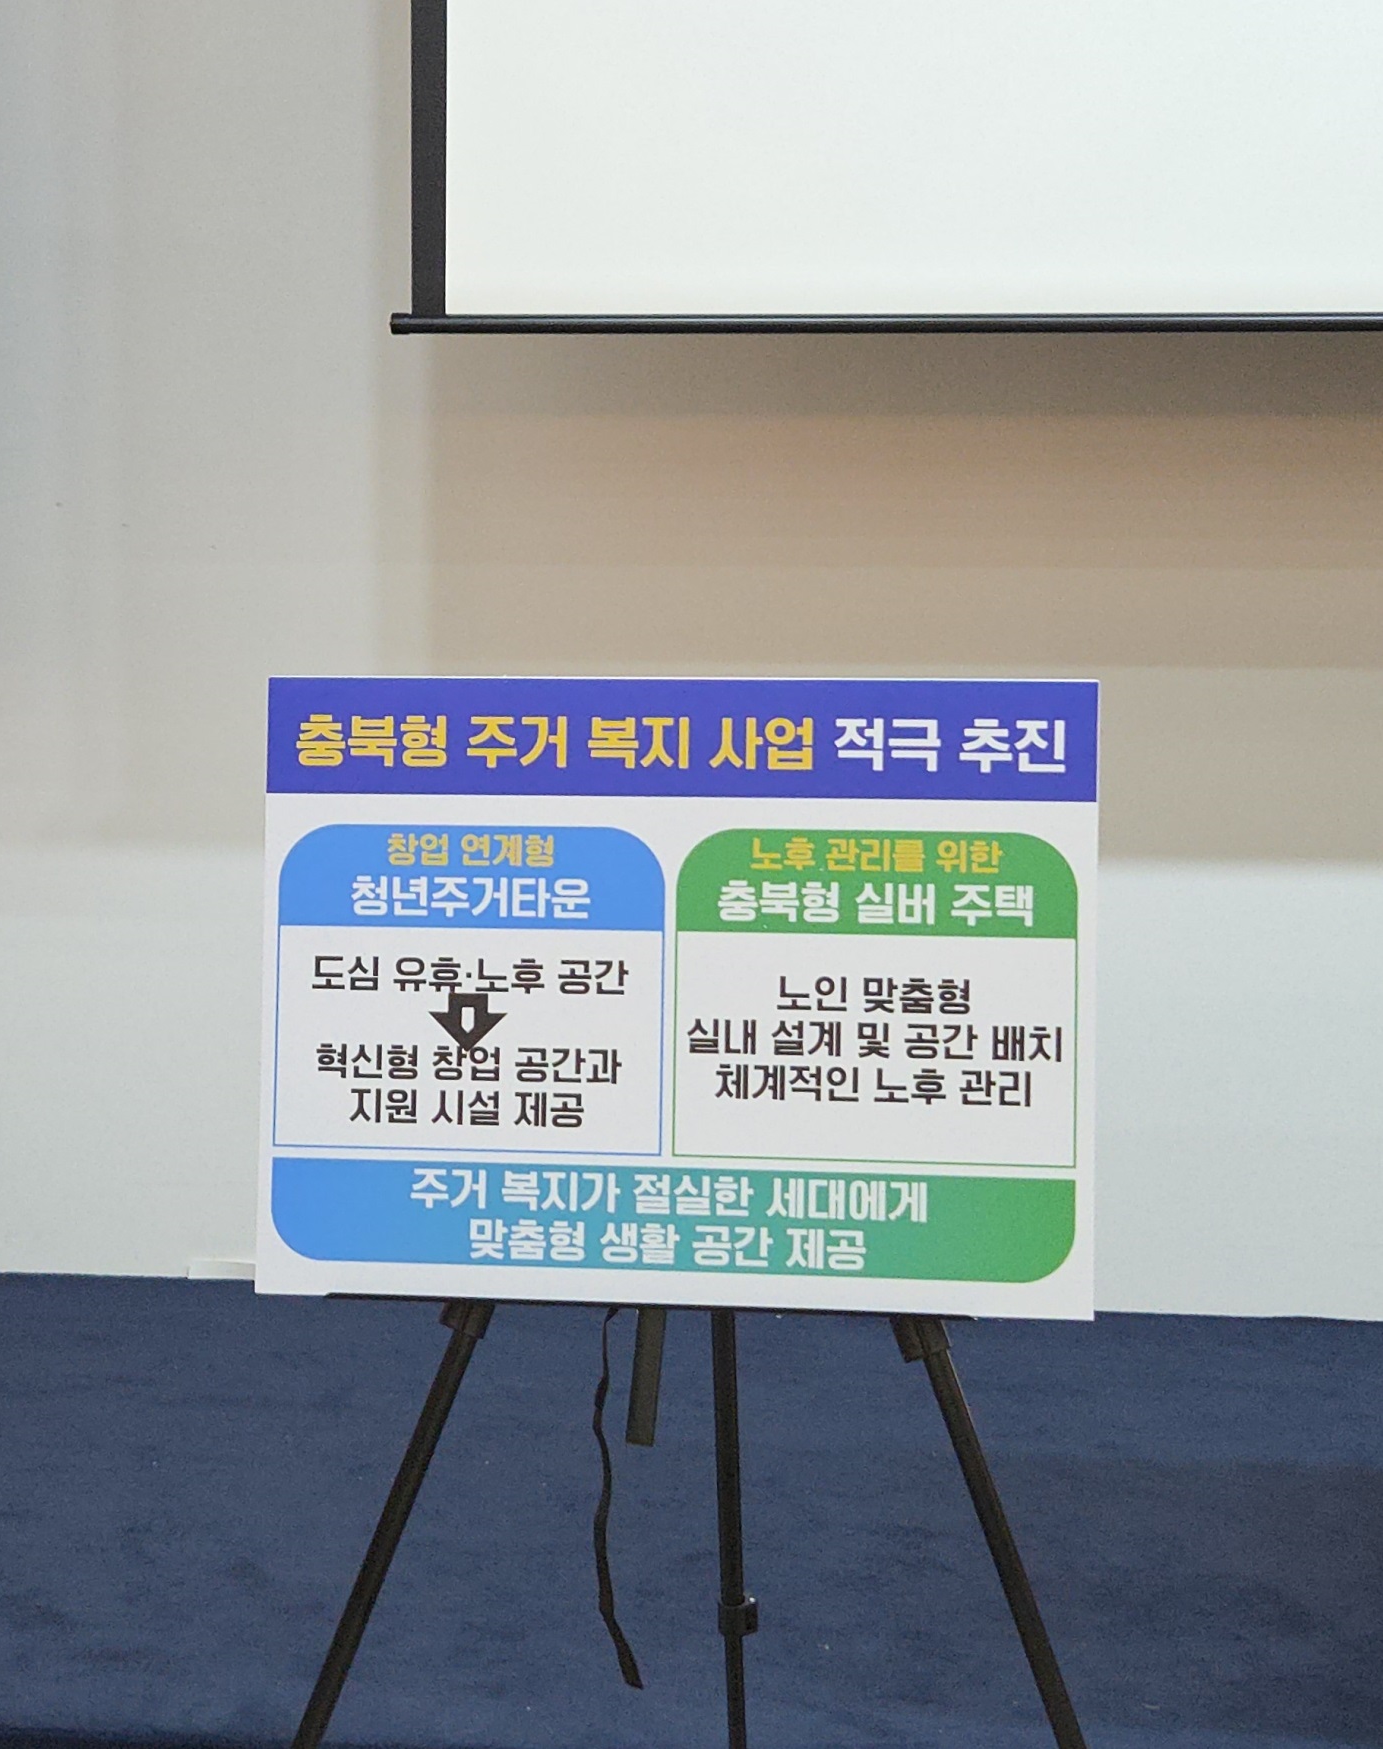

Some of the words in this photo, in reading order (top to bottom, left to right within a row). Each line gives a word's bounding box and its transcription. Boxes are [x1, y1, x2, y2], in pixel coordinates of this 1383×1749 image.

[295, 714, 448, 768] 충북형
[466, 715, 568, 769] 주거
[587, 716, 690, 770] 복지
[709, 717, 814, 771] 사업
[834, 718, 942, 773] 적극
[958, 718, 1067, 774] 추진
[386, 832, 449, 866] 창업
[460, 833, 555, 868] 연계형
[750, 836, 816, 871] 노후
[826, 837, 926, 873] 관리를
[936, 839, 1004, 874] 위한
[350, 874, 591, 919] 청년주거타운
[717, 879, 840, 924] 충북형
[855, 881, 936, 926] 실버
[951, 884, 1034, 928] 주택
[312, 955, 380, 992] 도심
[557, 959, 629, 996] 공간
[776, 975, 848, 1012] 노인
[862, 976, 971, 1015] 맞춤형
[687, 1017, 757, 1056] 실내
[771, 1019, 841, 1058] 설계
[857, 1021, 890, 1059] 및
[903, 1023, 978, 1061] 공간
[991, 1024, 1063, 1063] 배치
[316, 1042, 419, 1080] 혁신형
[431, 1044, 501, 1082] 창업
[514, 1046, 622, 1084] 공간과
[715, 1063, 859, 1103] 체계적인
[873, 1066, 946, 1105] 노후
[958, 1068, 1032, 1107] 관리
[349, 1087, 418, 1123] 지원
[431, 1089, 501, 1126] 시설
[514, 1091, 585, 1128] 제공
[410, 1167, 490, 1210] 주거
[500, 1169, 621, 1214] 복지가
[632, 1172, 754, 1218] 절실한
[766, 1176, 928, 1223] 세대에게
[468, 1218, 585, 1261] 맞춤형
[599, 1221, 679, 1264] 생활
[692, 1224, 773, 1268] 공간
[785, 1227, 868, 1271] 제공
